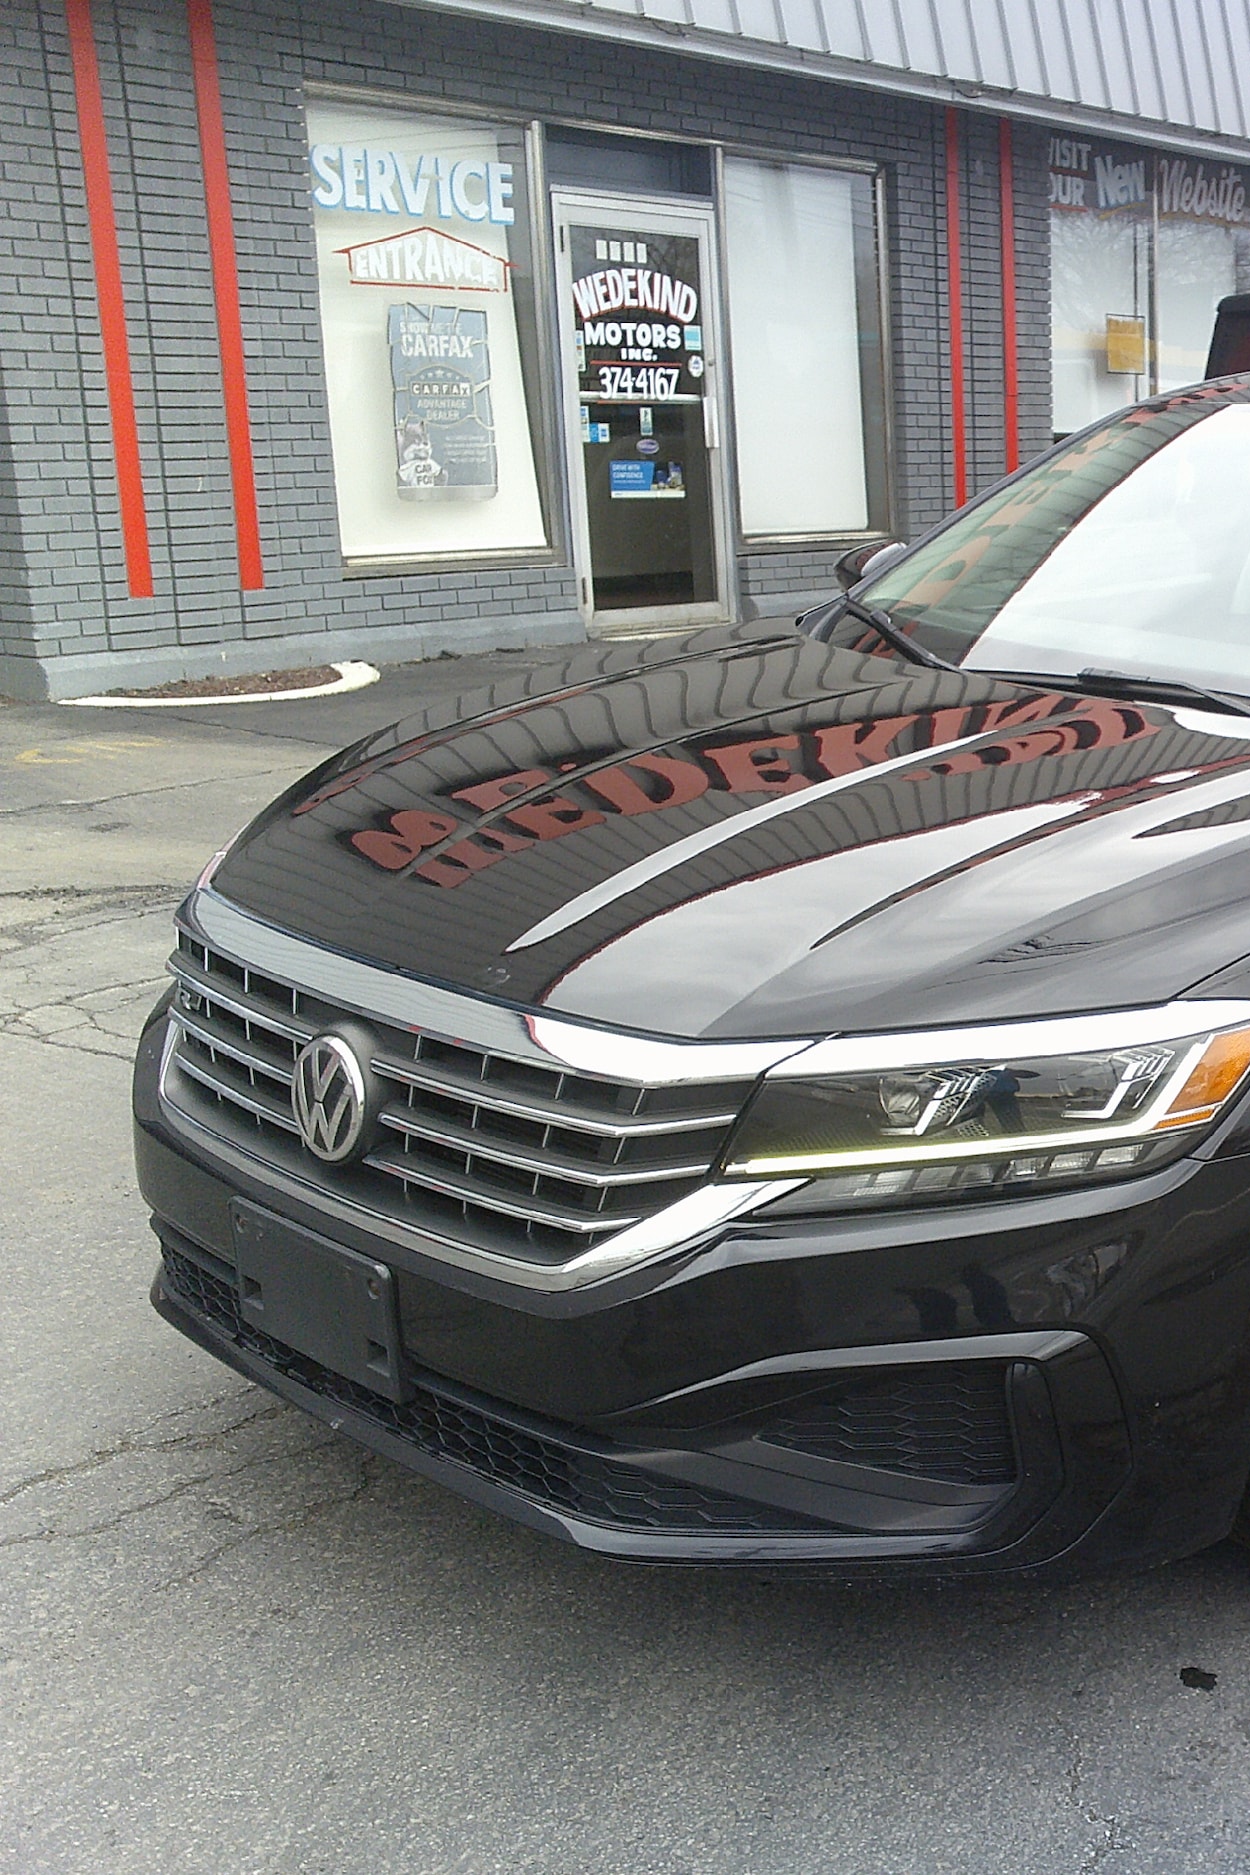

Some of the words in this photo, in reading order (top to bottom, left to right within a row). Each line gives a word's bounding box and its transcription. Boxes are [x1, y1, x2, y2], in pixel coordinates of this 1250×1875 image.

[310, 144, 515, 225] SERVICE
[1158, 158, 1246, 222] Website
[355, 233, 499, 285] ENTRANCE
[572, 268, 698, 324] WEDEKIND
[401, 333, 474, 358] CARFAX
[583, 321, 682, 349] MOTORS
[620, 348, 658, 361] INC.
[411, 382, 471, 397] CARFAX
[599, 366, 680, 400] 374-4167
